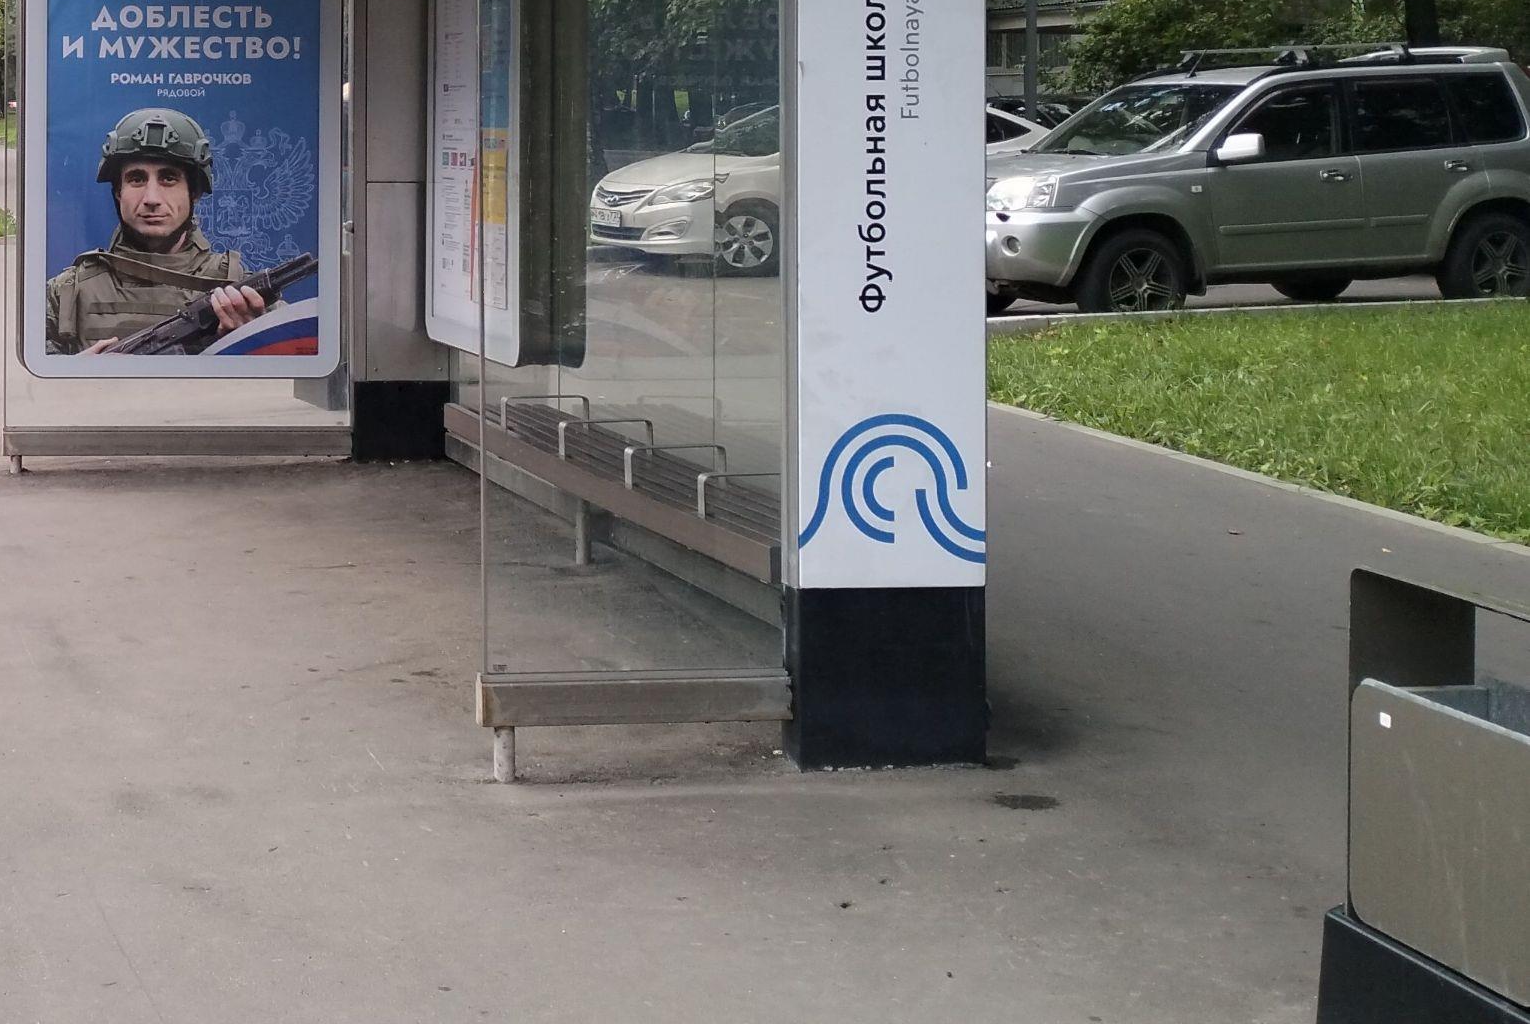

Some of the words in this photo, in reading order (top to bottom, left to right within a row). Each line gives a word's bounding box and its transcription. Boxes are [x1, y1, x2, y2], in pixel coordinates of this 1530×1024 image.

[91, 5, 273, 31] ДОБЛЕСТЬ
[62, 36, 85, 58] И
[99, 35, 301, 60] МУЖЕСТВО!
[110, 72, 164, 85] РОМАН
[168, 72, 252, 85] ГАВРОЧКОВ
[157, 86, 206, 98] РЯДОВОЙ
[858, 94, 893, 313] Футбольная
